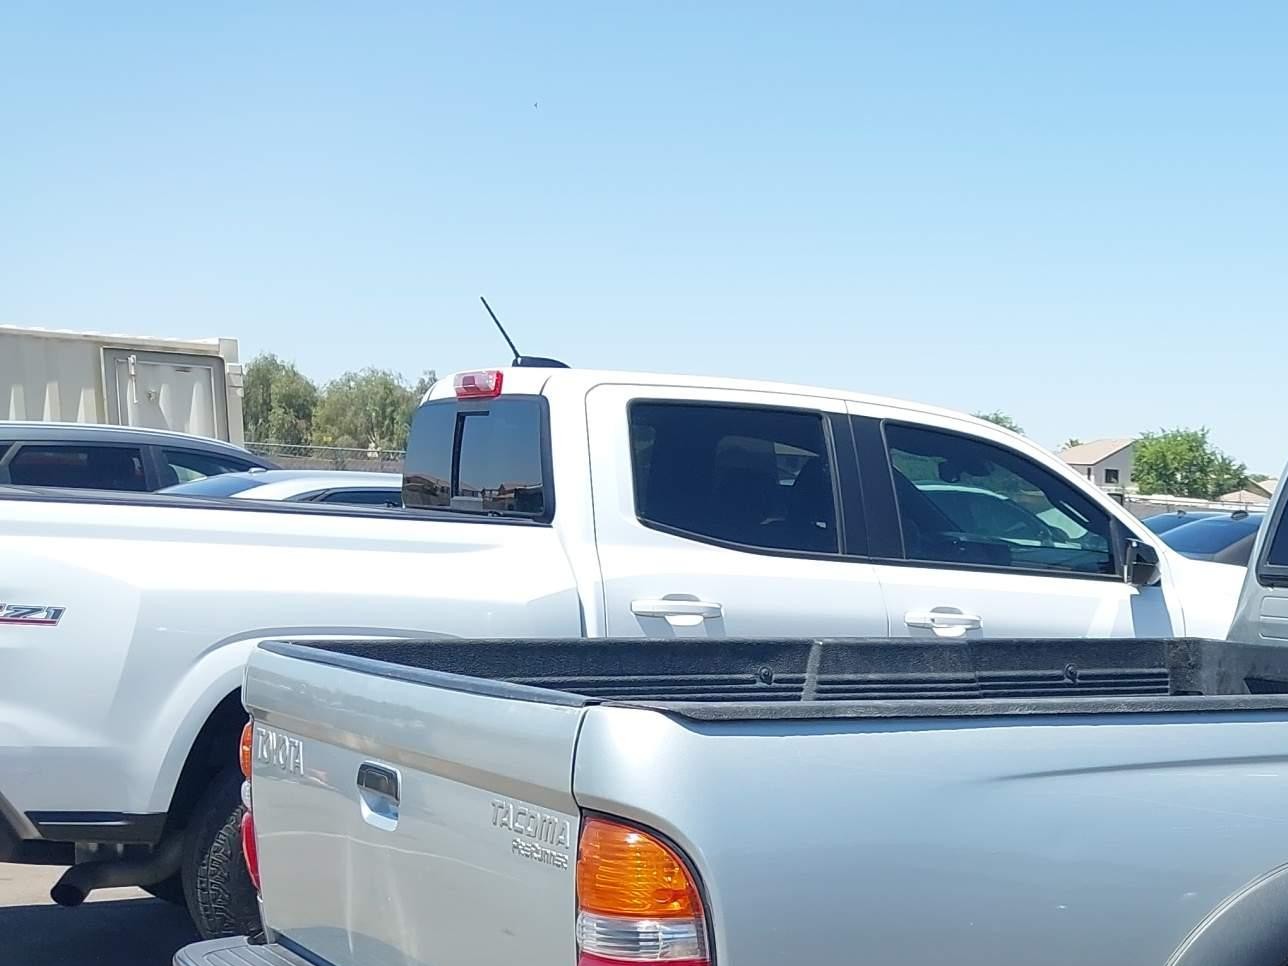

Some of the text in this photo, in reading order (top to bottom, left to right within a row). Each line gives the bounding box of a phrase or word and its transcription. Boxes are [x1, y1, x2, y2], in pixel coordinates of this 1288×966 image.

[0, 603, 66, 620] 71
[256, 727, 304, 776] TOYOTA
[490, 799, 570, 849] TACOMA
